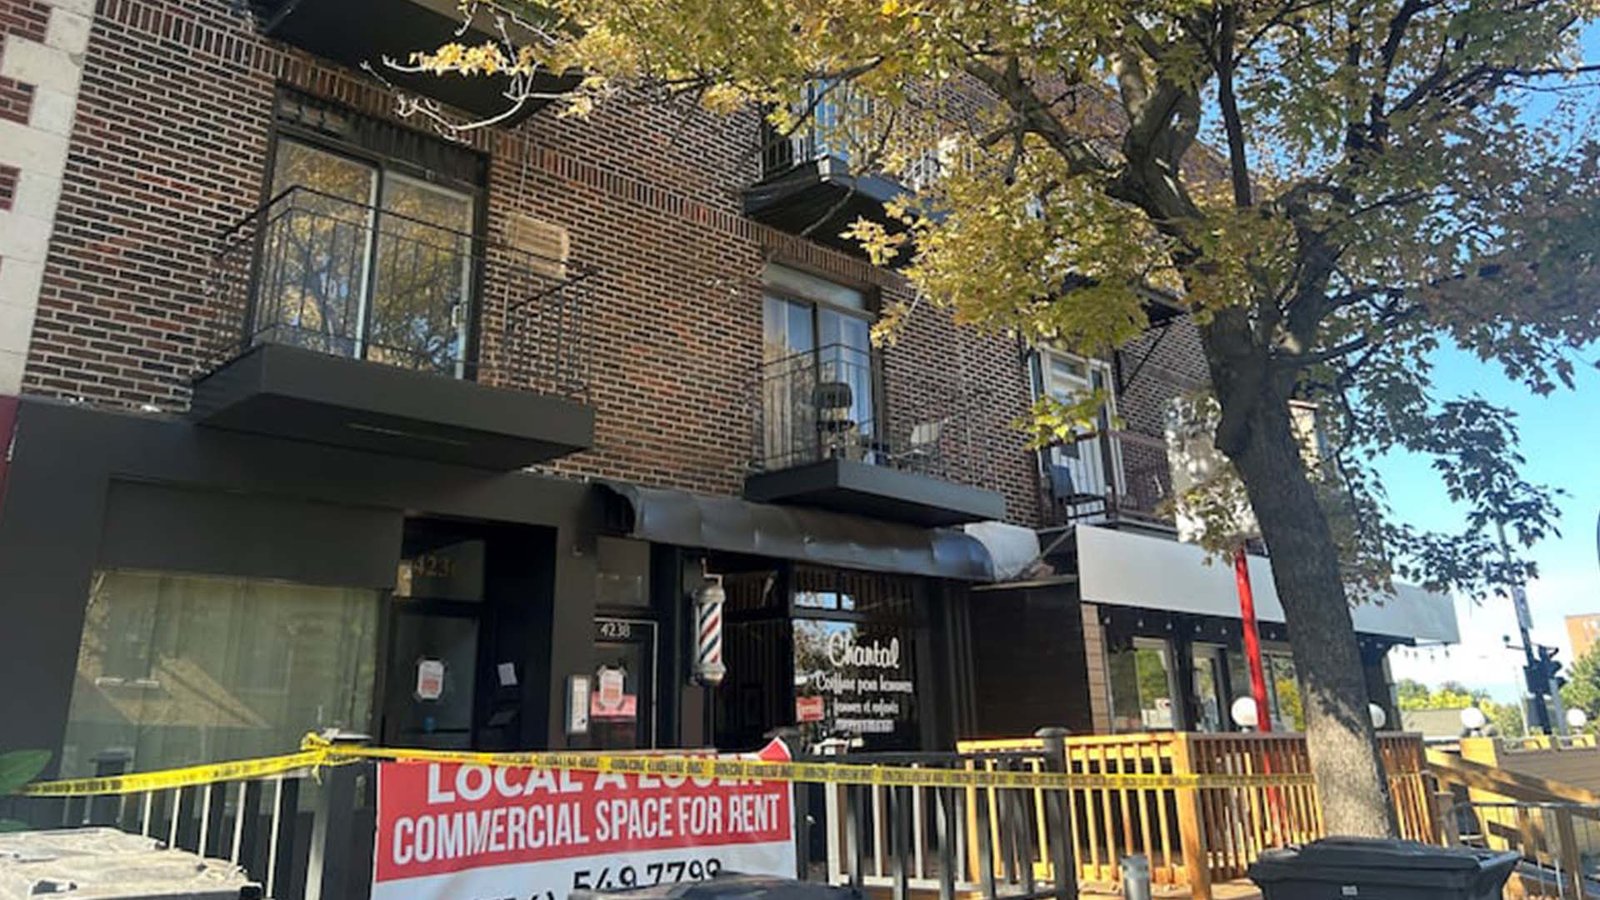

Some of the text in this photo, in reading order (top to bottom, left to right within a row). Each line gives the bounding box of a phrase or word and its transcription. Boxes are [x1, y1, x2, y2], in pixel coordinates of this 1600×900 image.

[828, 630, 900, 669] Chantal
[427, 763, 584, 804] LOCAL
[392, 793, 781, 865] COMMERCIAL SPACE FOR RENT
